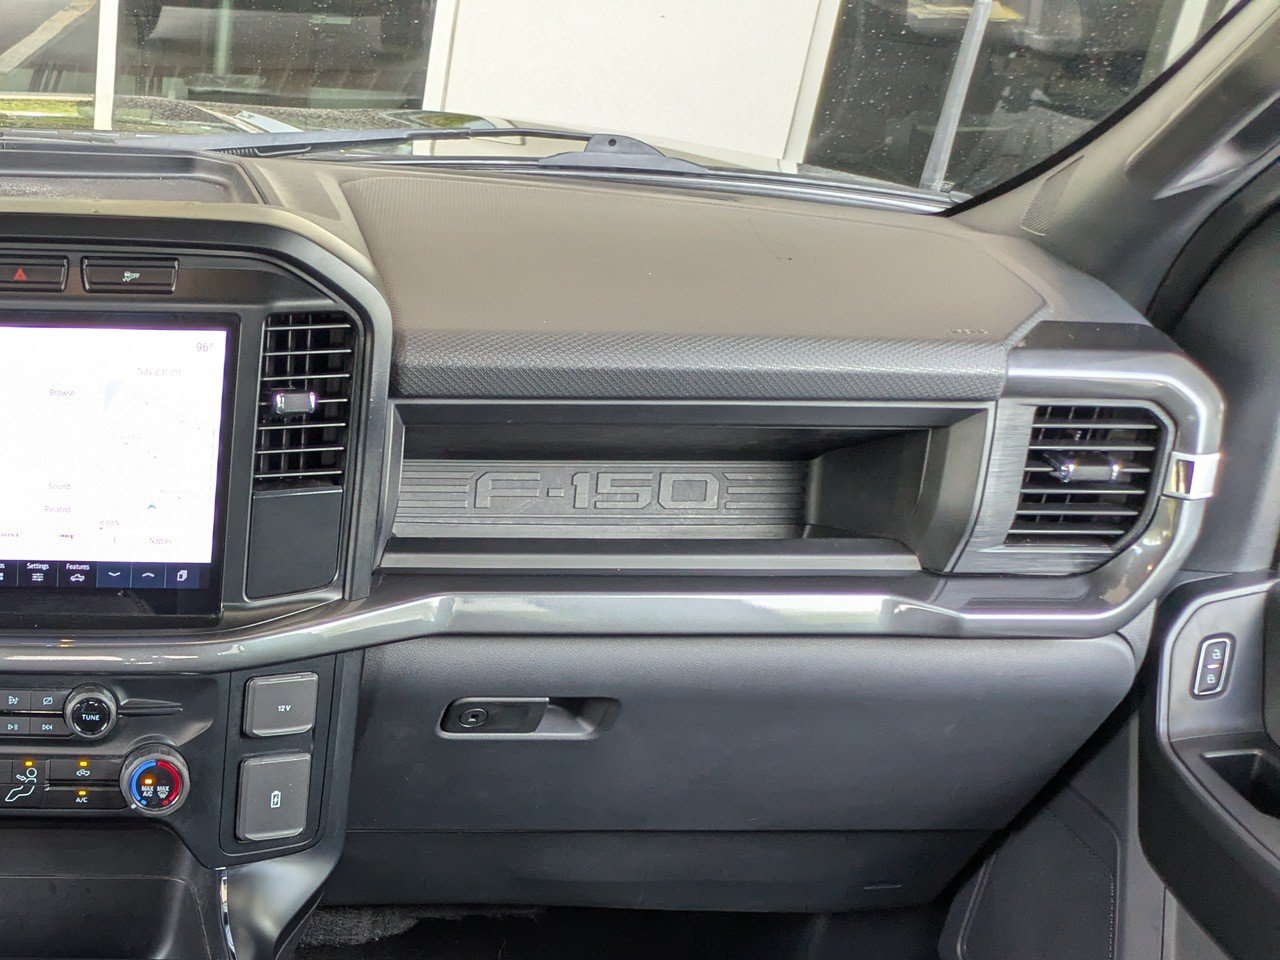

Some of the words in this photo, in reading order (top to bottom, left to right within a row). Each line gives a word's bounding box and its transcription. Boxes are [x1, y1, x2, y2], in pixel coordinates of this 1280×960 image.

[49, 388, 75, 397] Browse
[49, 481, 70, 490] Sound
[474, 470, 720, 509] F-150
[45, 505, 70, 513] Related
[27, 562, 49, 570] Settings
